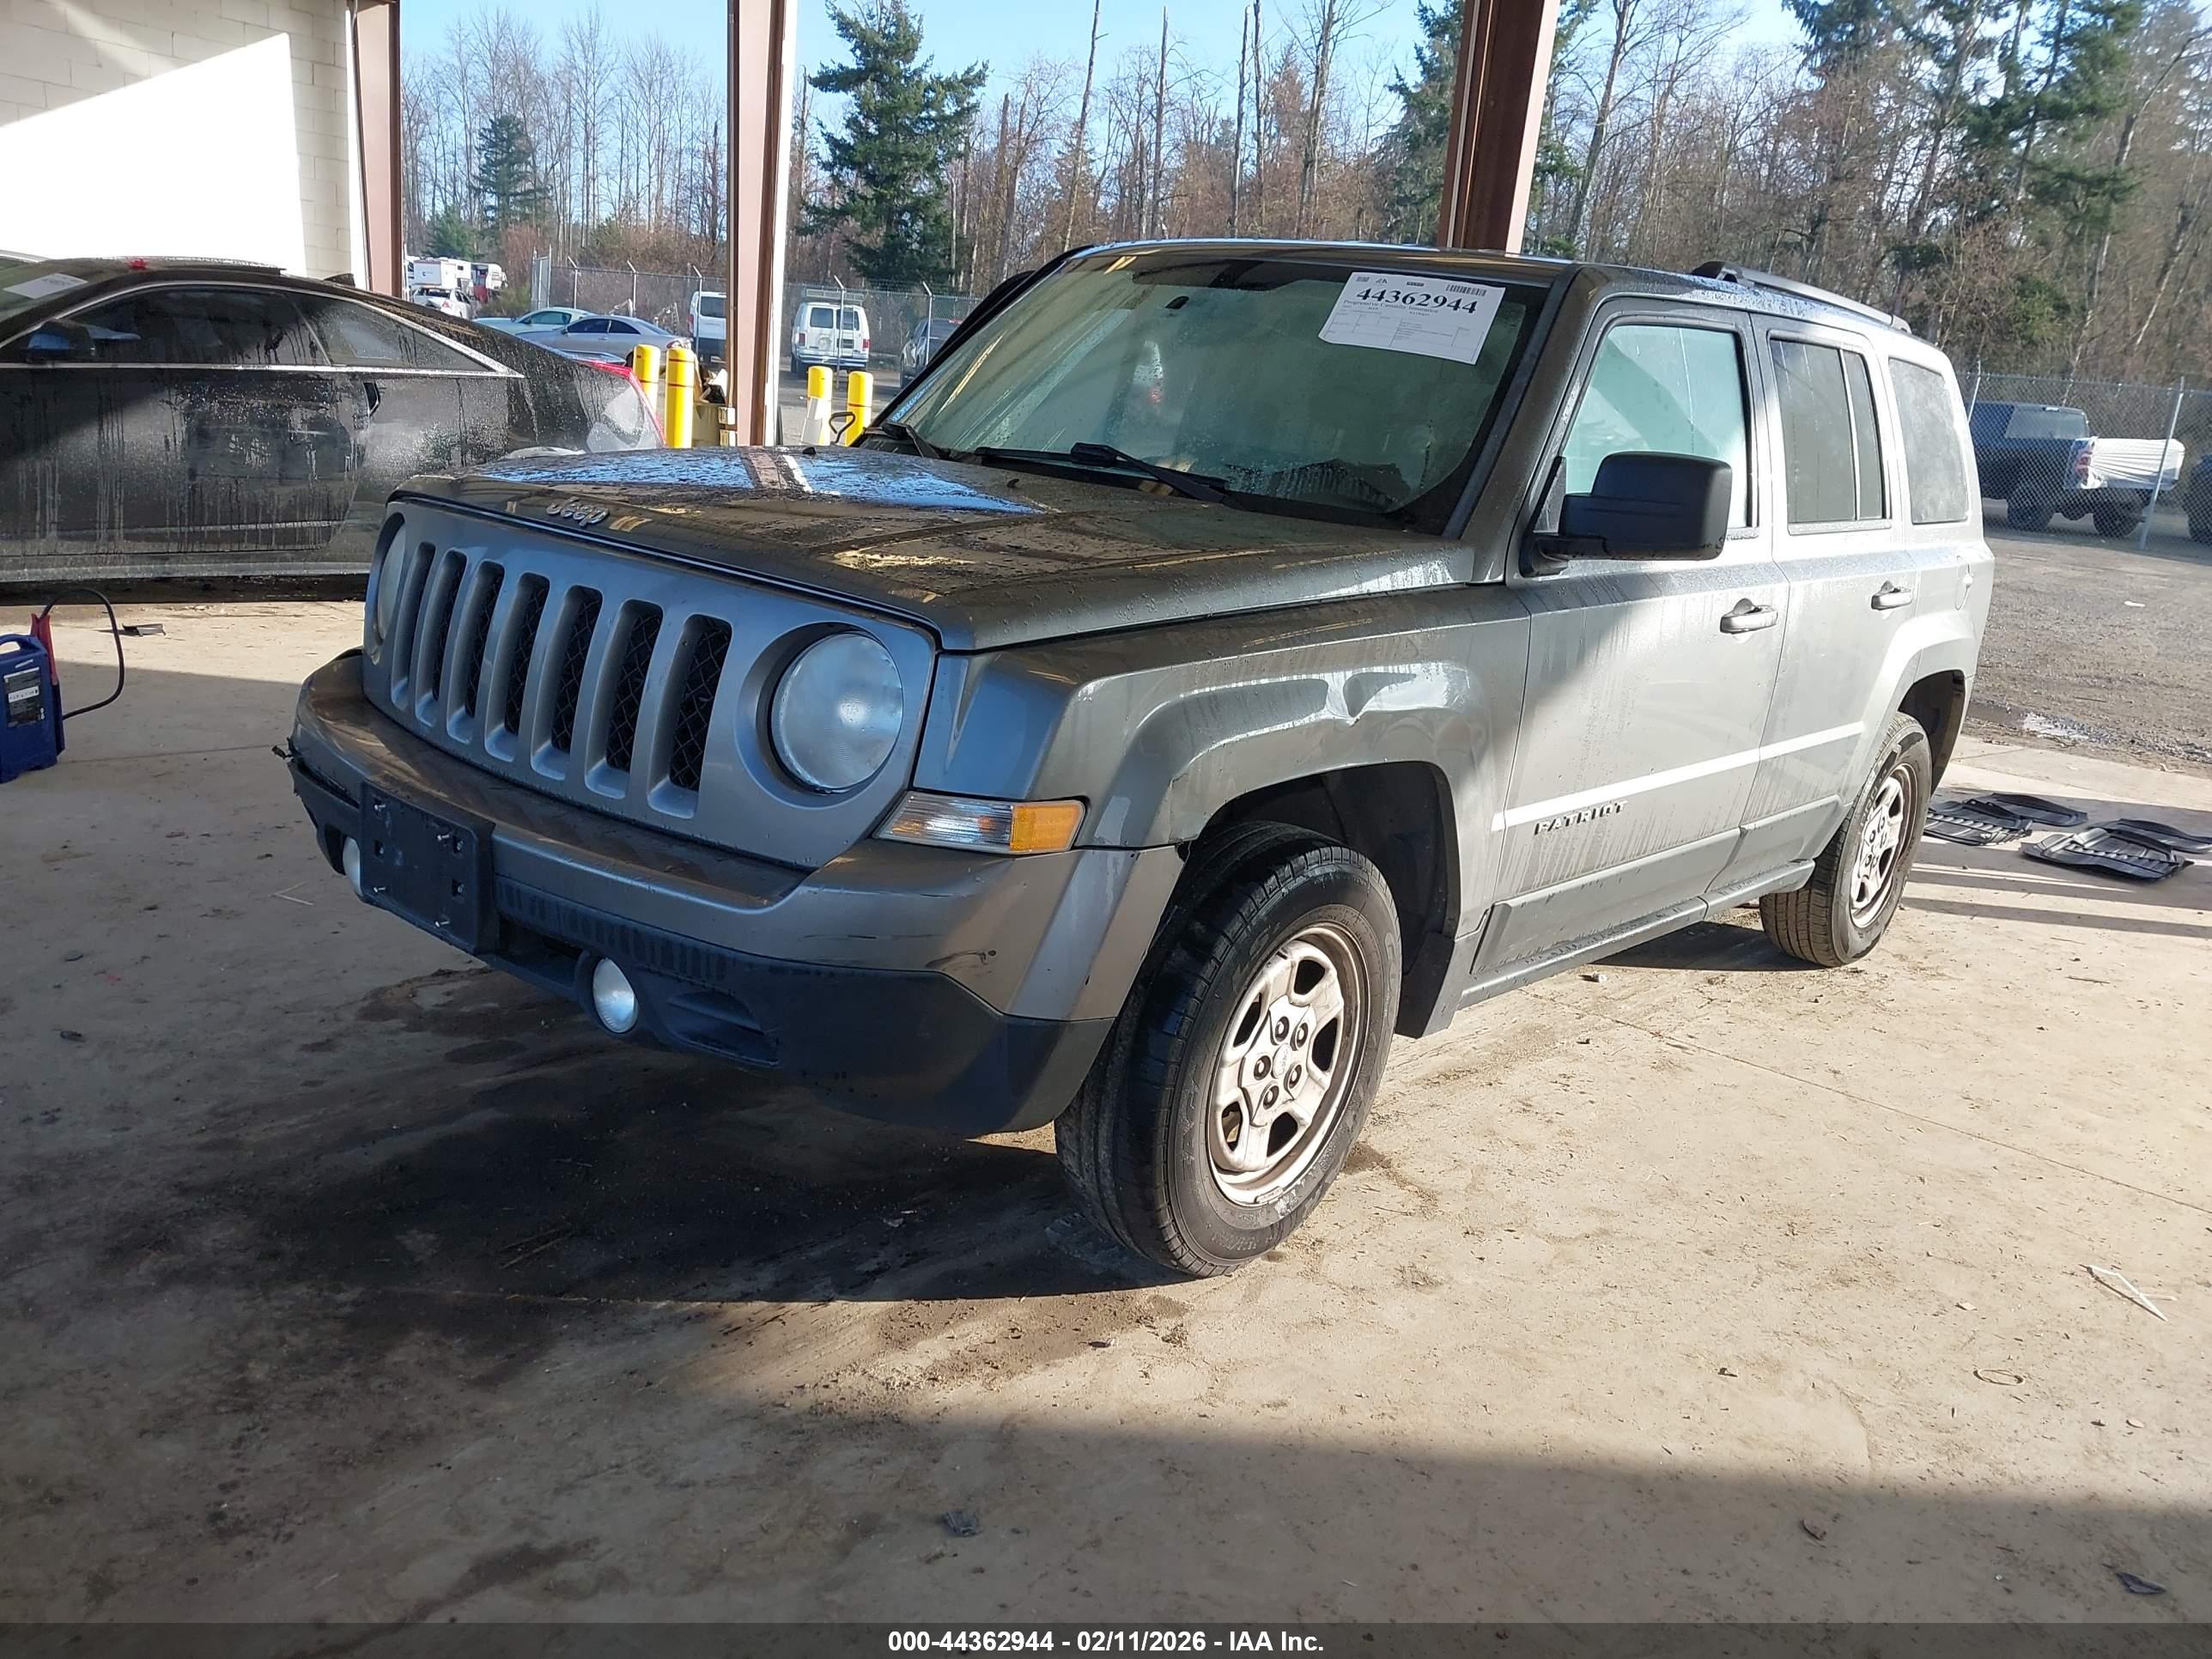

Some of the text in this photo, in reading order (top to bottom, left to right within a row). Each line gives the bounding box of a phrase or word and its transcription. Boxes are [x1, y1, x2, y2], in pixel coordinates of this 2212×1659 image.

[1356, 288, 1477, 314] 44362944
[546, 495, 610, 526] Jeep
[1534, 799, 1628, 836] PATRIOT
